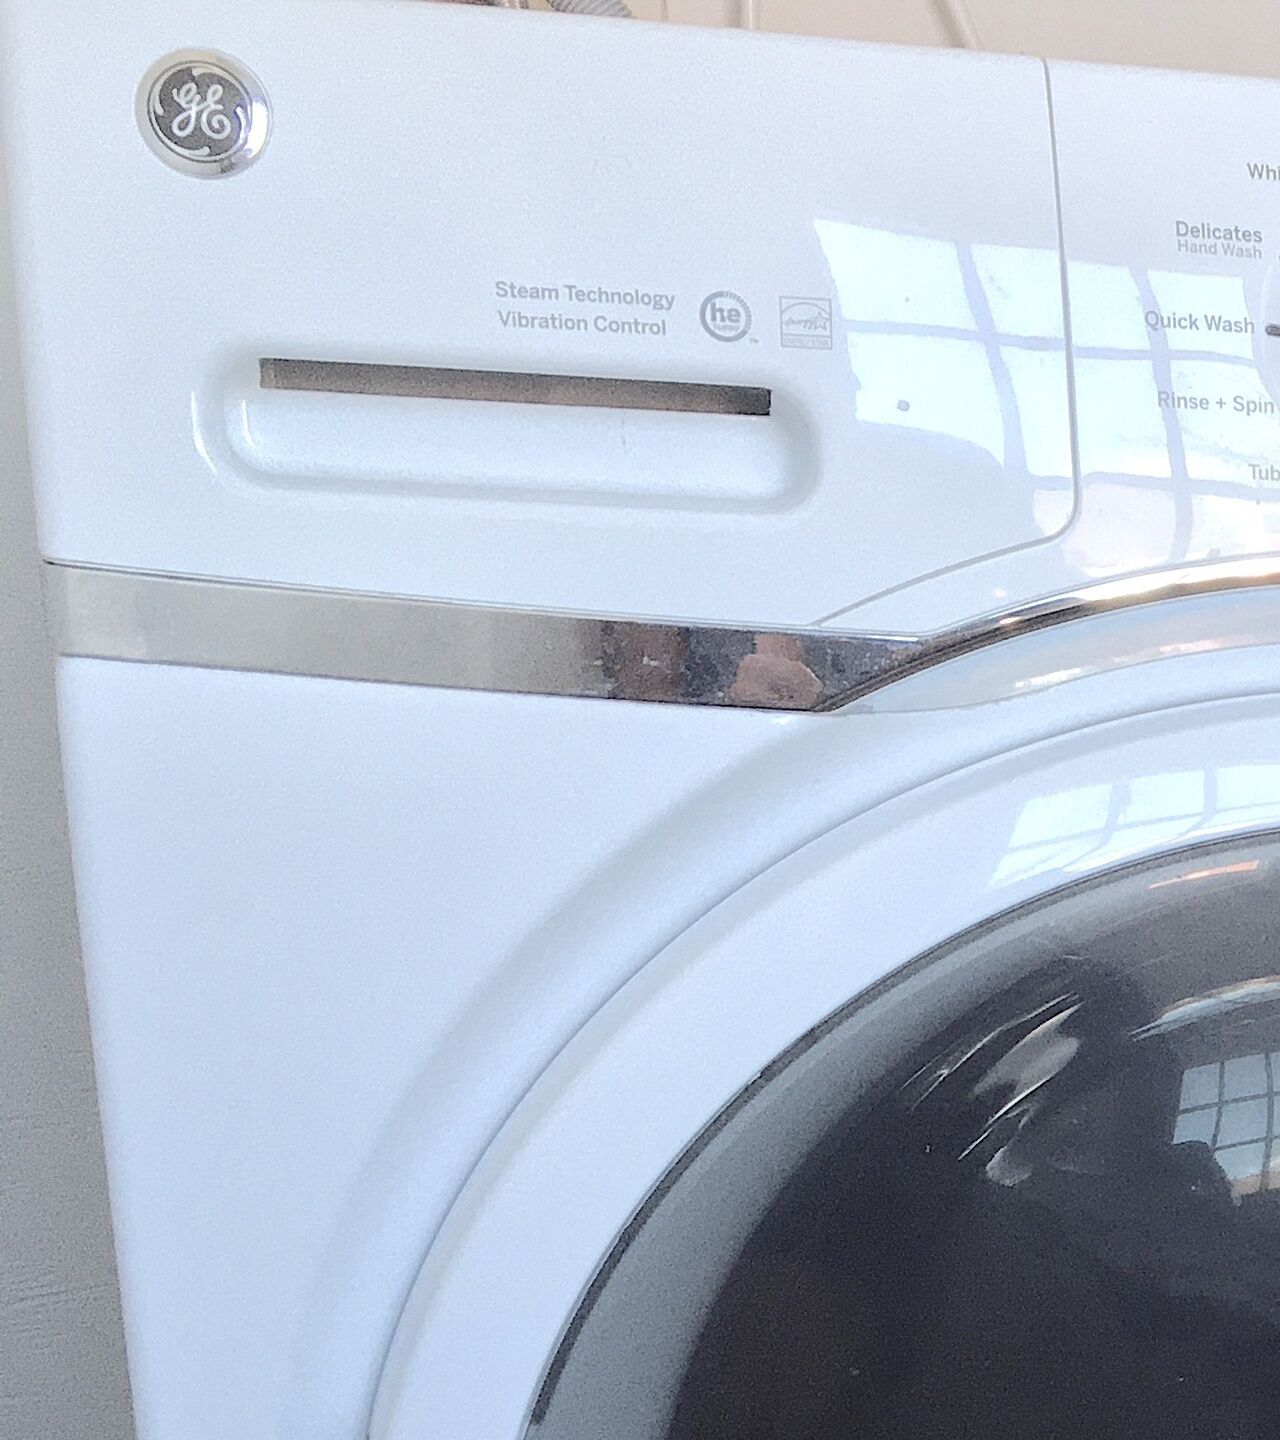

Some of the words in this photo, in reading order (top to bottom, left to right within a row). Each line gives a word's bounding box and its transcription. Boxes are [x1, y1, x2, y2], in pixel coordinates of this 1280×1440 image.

[171, 82, 231, 140] GE
[1175, 220, 1263, 243] Delicates
[1177, 239, 1218, 255] Hand
[1221, 242, 1262, 259] Wash
[495, 280, 559, 302] Steam
[564, 285, 676, 311] Technology
[497, 310, 588, 332] Vibration
[594, 315, 667, 336] Control
[710, 301, 742, 323] he
[1144, 310, 1200, 332] Quick
[1204, 314, 1255, 334] Wash
[1157, 391, 1210, 410] Rinse
[1216, 397, 1227, 409] +
[1232, 395, 1275, 416] Spin
